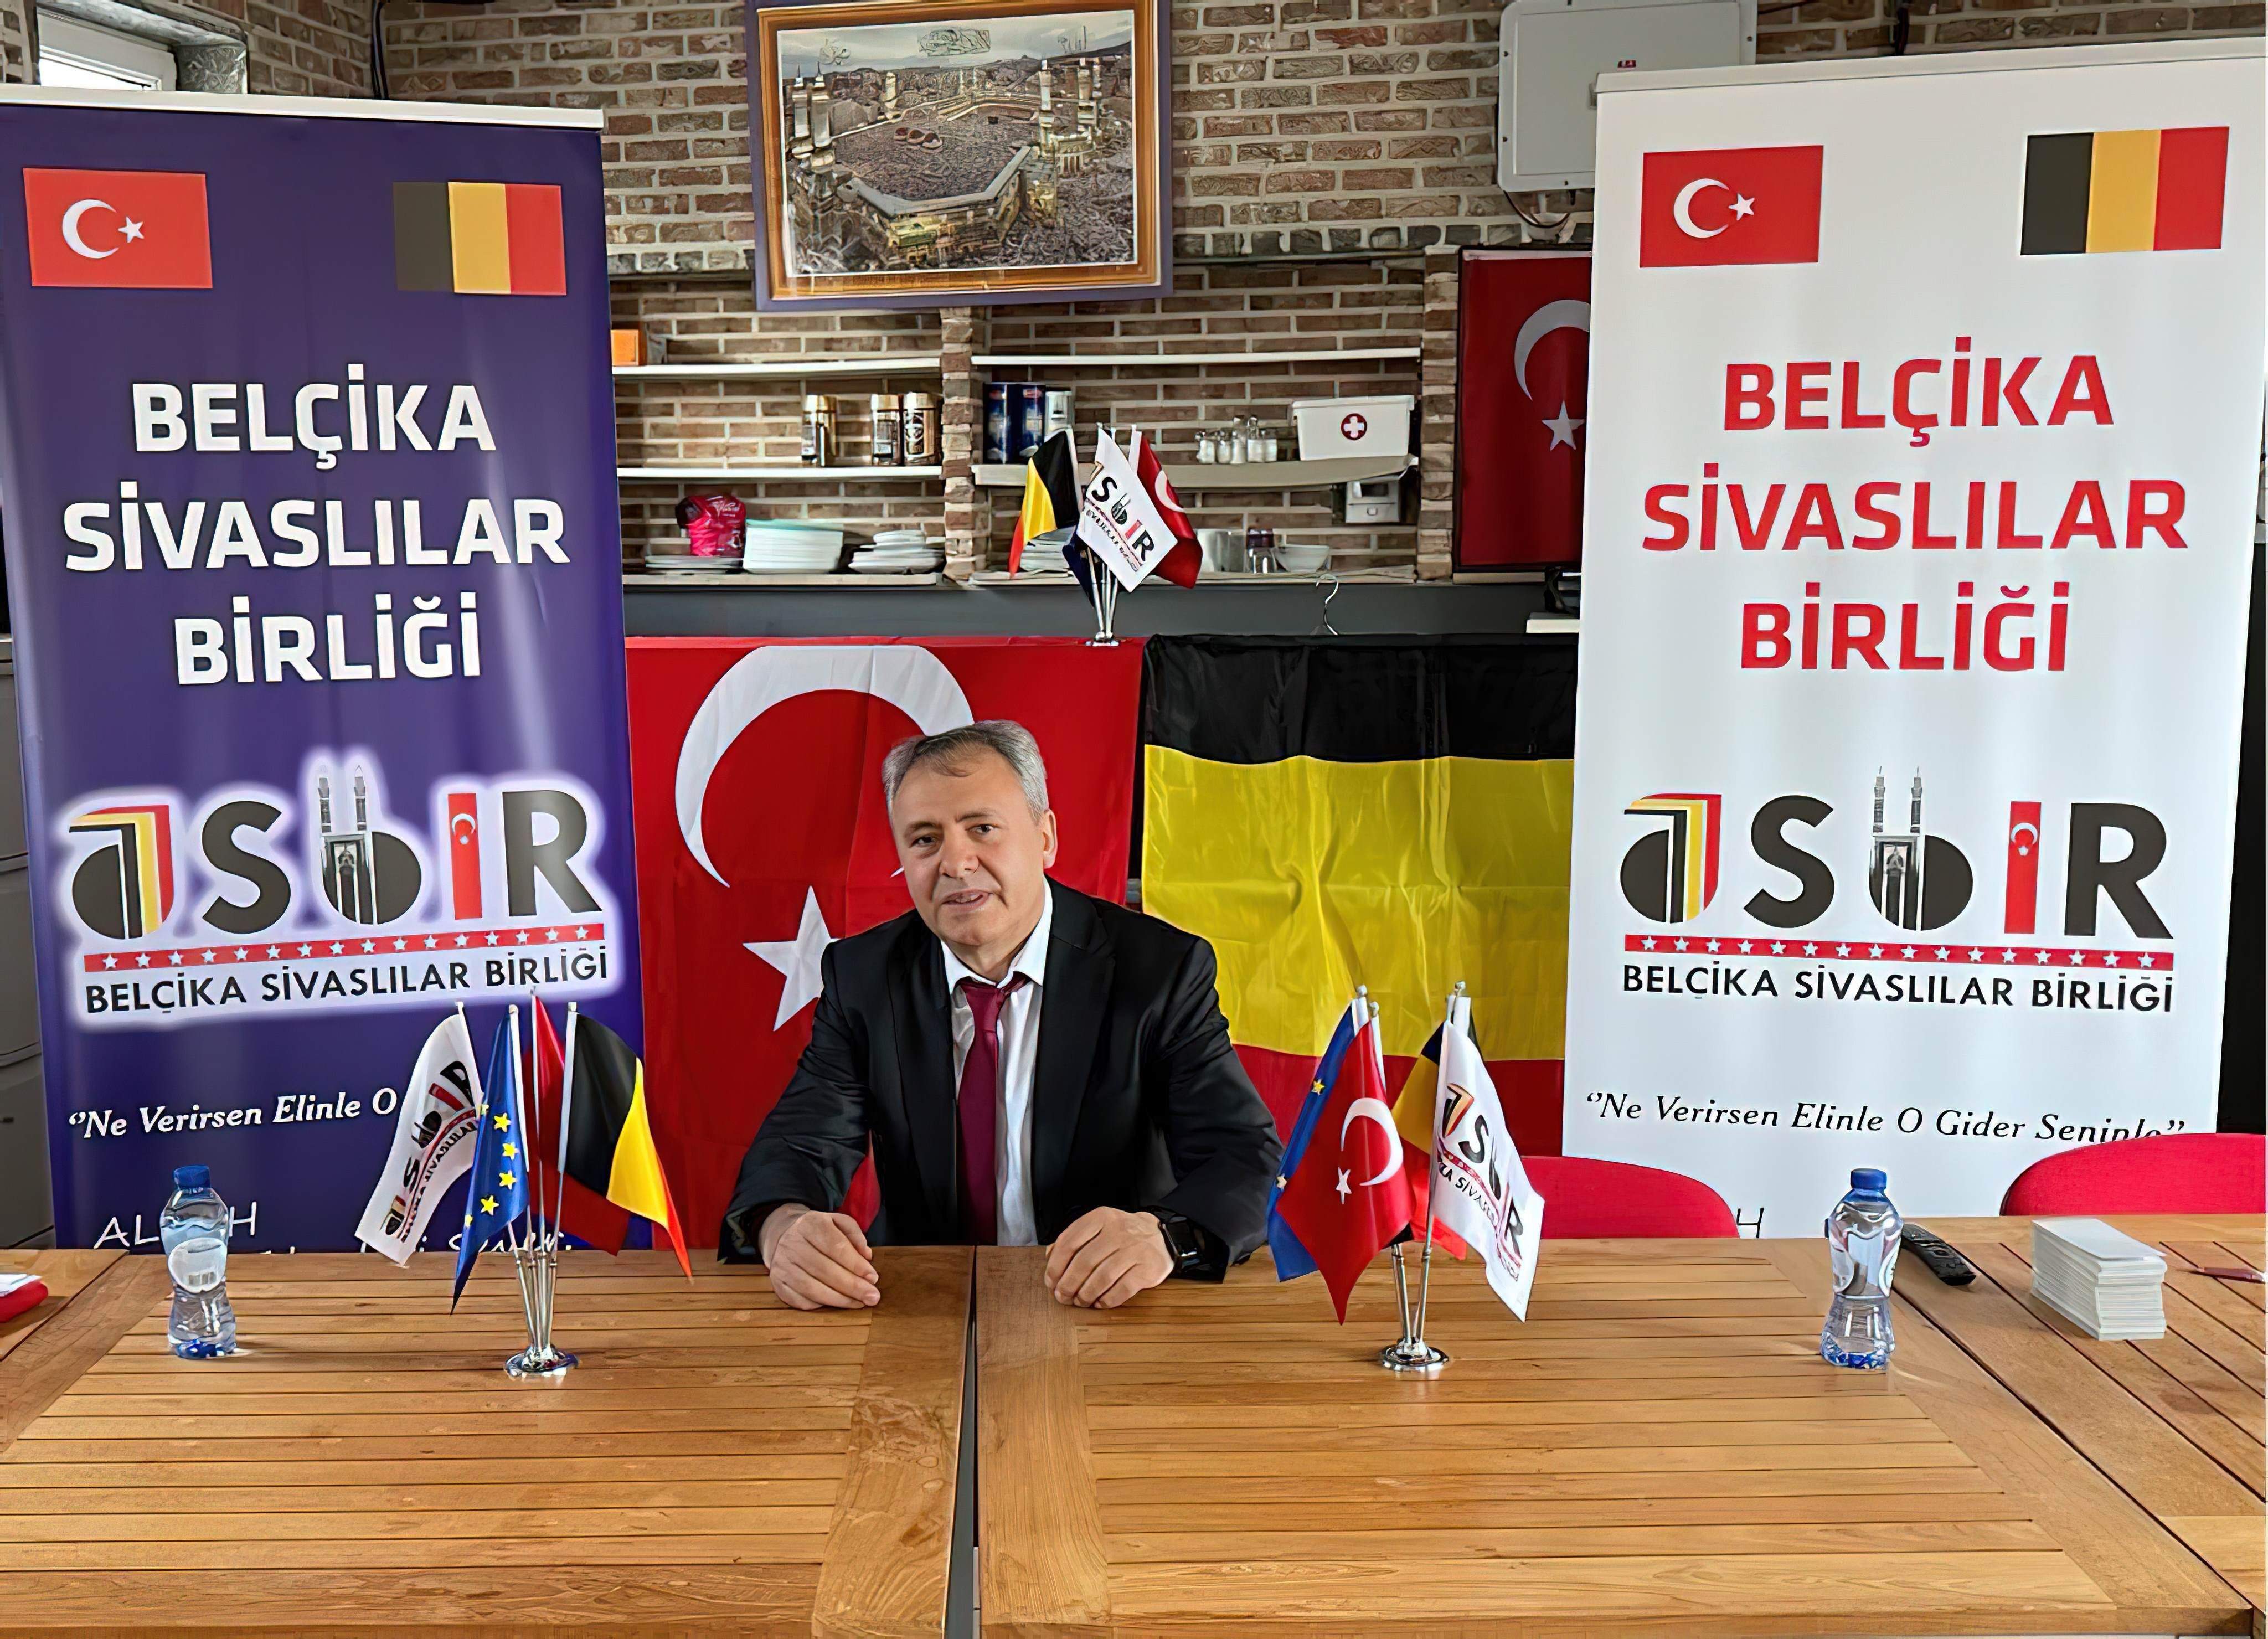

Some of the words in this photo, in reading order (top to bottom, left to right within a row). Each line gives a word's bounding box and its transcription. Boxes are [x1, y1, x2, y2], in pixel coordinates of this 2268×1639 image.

[132, 363, 495, 470] BELÇİKA
[1724, 336, 2114, 447] BELÇİKA
[64, 481, 570, 571] SİVASLILAR
[1642, 463, 2188, 551] SİVASLILAR
[174, 592, 480, 684] BİRLİĞİ
[1741, 581, 2069, 671] BİRLİĞİ
[86, 972, 246, 1013] BELÇİKA
[262, 962, 470, 1001] SİVASLILAR
[486, 946, 607, 987] BİRLİĞİ
[1623, 961, 1778, 999] BELÇİKA
[1795, 964, 2013, 1006] SİVASLILAR
[2032, 973, 2173, 1012] BİRLİĞİ
[139, 1104, 261, 1133] Verirsen
[272, 1092, 360, 1123] Elinle
[372, 1087, 397, 1115] O
[1657, 1095, 1779, 1126] Verirsen
[1791, 1102, 1883, 1131] Elinle
[1897, 1107, 1923, 1133] O
[1936, 1109, 2025, 1138] Gider
[93, 1201, 256, 1249] ALH
